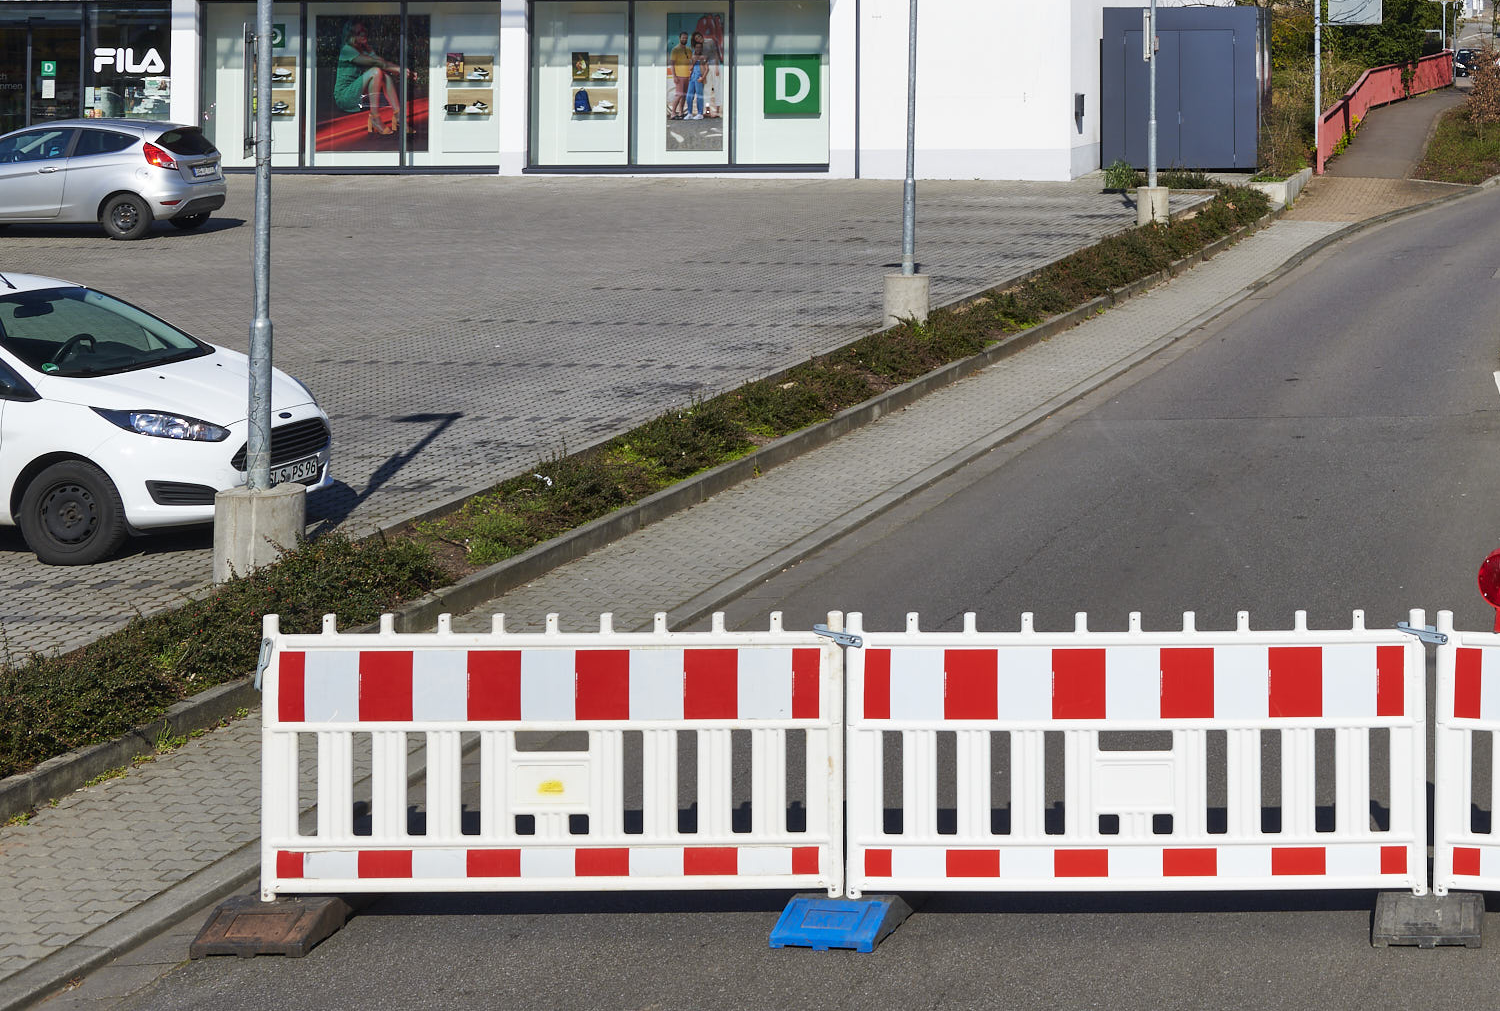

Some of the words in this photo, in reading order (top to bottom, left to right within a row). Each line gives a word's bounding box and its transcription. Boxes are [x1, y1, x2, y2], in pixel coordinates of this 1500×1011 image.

[94, 47, 165, 74] FILA
[776, 66, 811, 104] D
[292, 463, 303, 480] PS
[305, 461, 315, 476] 96
